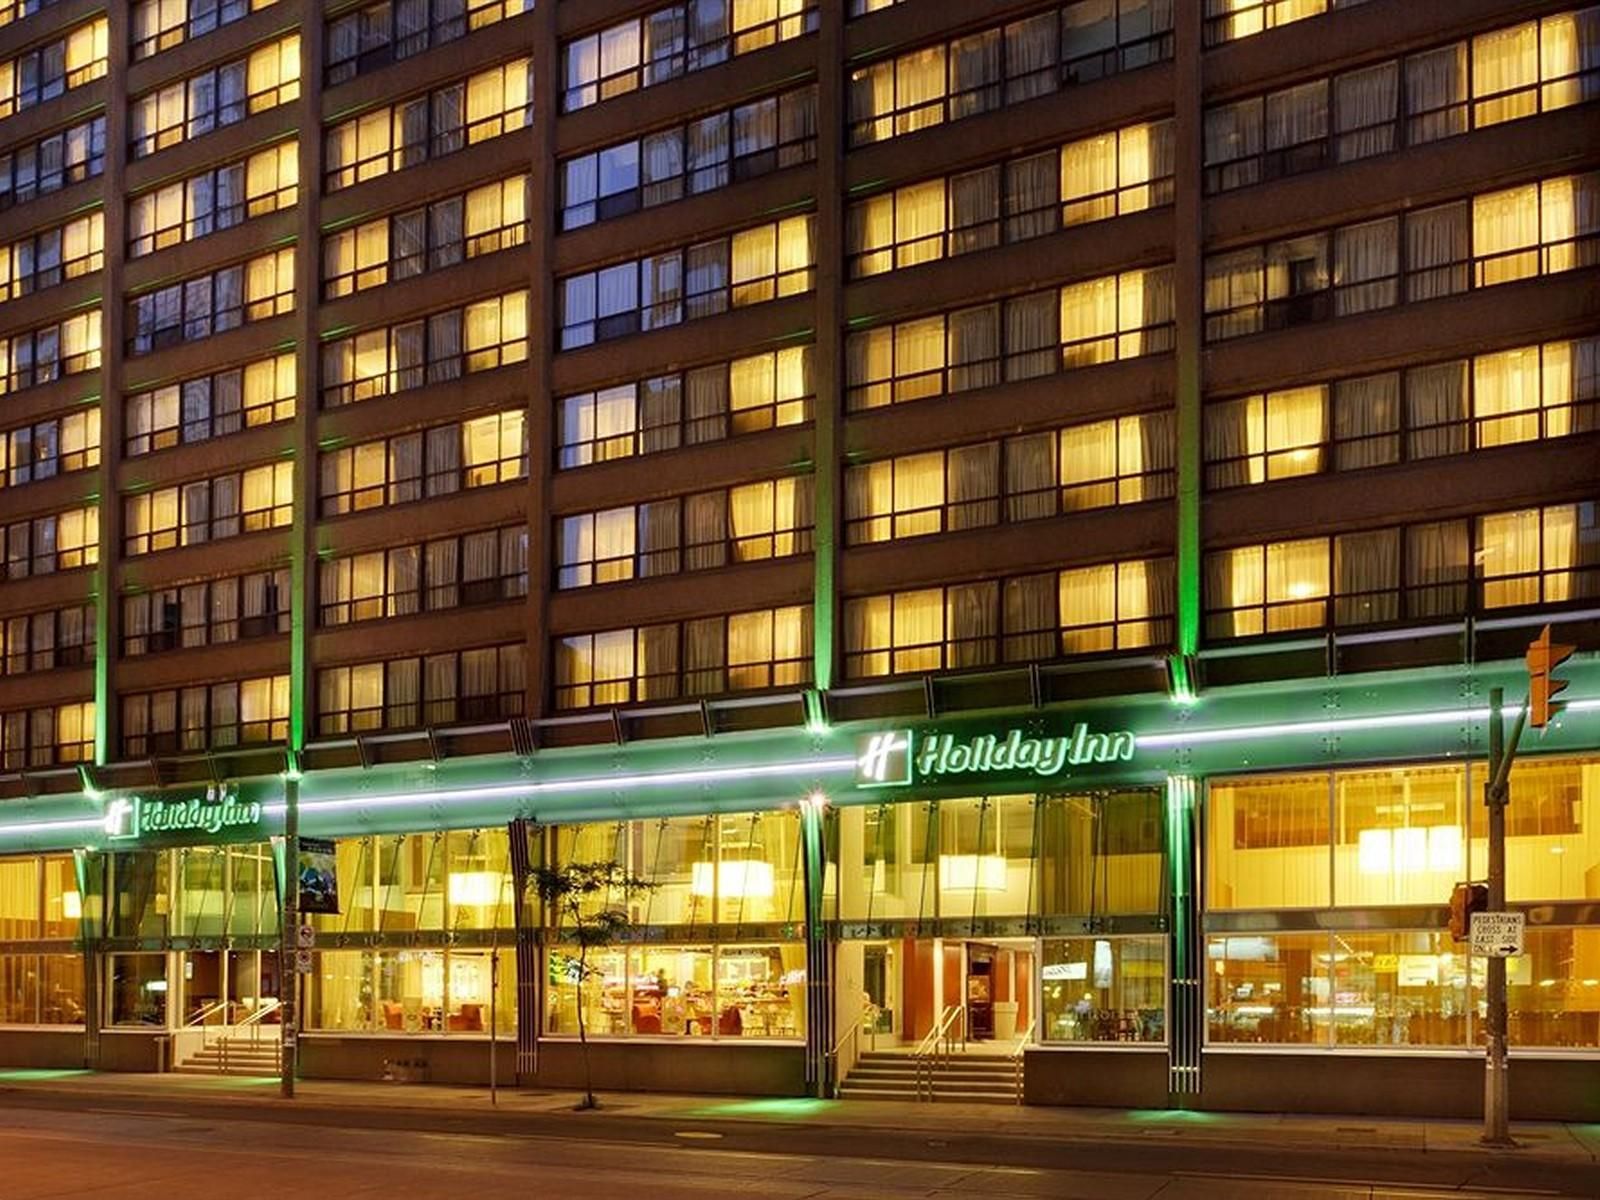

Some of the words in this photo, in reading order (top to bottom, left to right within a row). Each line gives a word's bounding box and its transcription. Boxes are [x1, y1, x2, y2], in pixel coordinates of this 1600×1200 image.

[918, 731, 1067, 775] Holiday
[1066, 723, 1135, 764] Inn
[1473, 915, 1521, 924] PEDESTRIANS
[1477, 925, 1501, 934] CROSS
